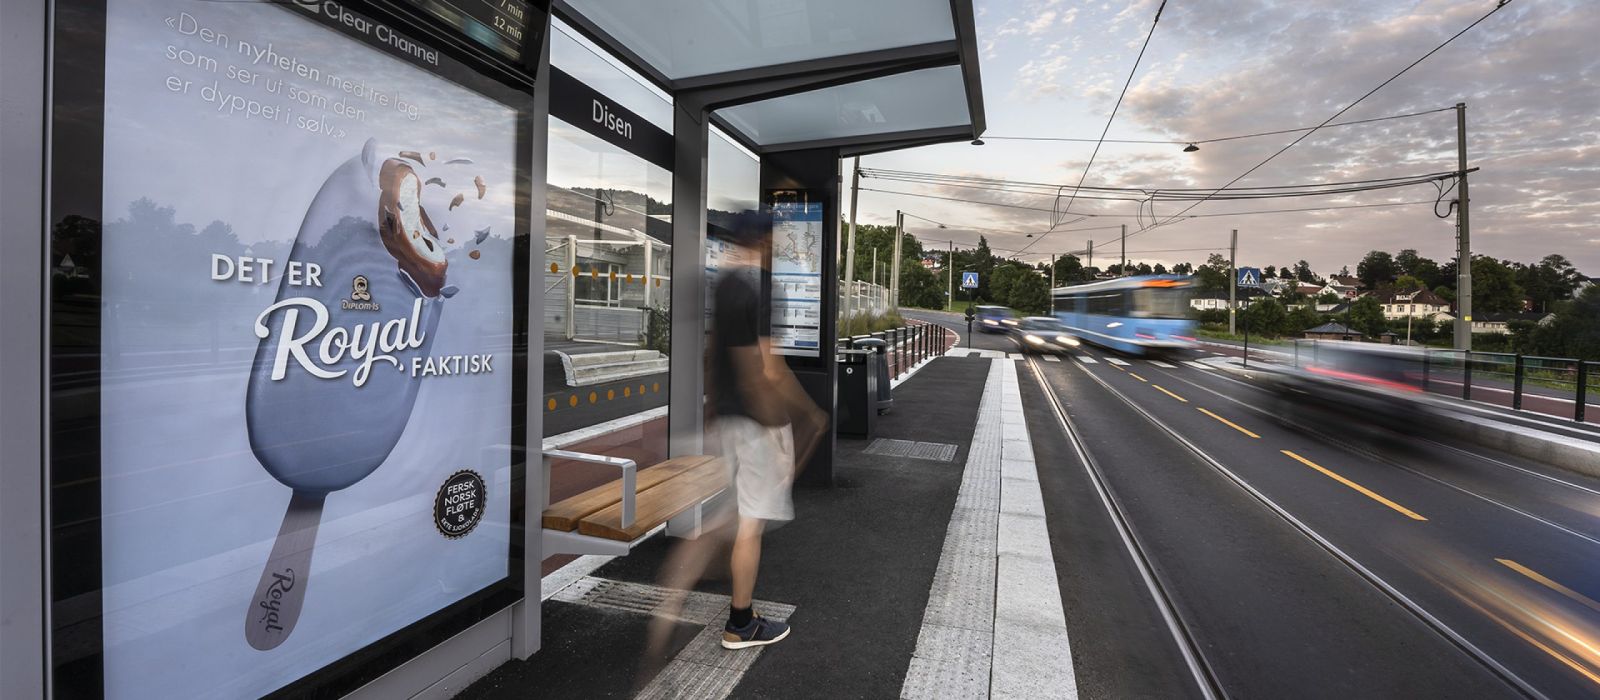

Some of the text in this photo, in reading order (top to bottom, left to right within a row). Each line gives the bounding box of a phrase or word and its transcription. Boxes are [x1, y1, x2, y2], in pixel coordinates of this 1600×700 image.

[494, 15, 522, 40] 12 min
[508, 3, 523, 19] min
[324, 0, 439, 66] Clear Channel
[165, 12, 228, 48] «Den
[239, 40, 320, 82] nyheten
[326, 73, 365, 98] med
[369, 87, 389, 106] tre
[166, 44, 365, 121] som ser ut som den
[166, 75, 193, 94] er
[200, 81, 281, 121] dyppet
[592, 99, 632, 140] Disen
[211, 253, 323, 287] DET ER
[254, 297, 426, 388] Royal
[411, 353, 493, 378] FAKTISK
[444, 489, 477, 506] NORSK
[447, 480, 475, 496] FERSK
[446, 499, 475, 516] FLØTE
[458, 514, 464, 522] &
[258, 568, 295, 633] Royal
